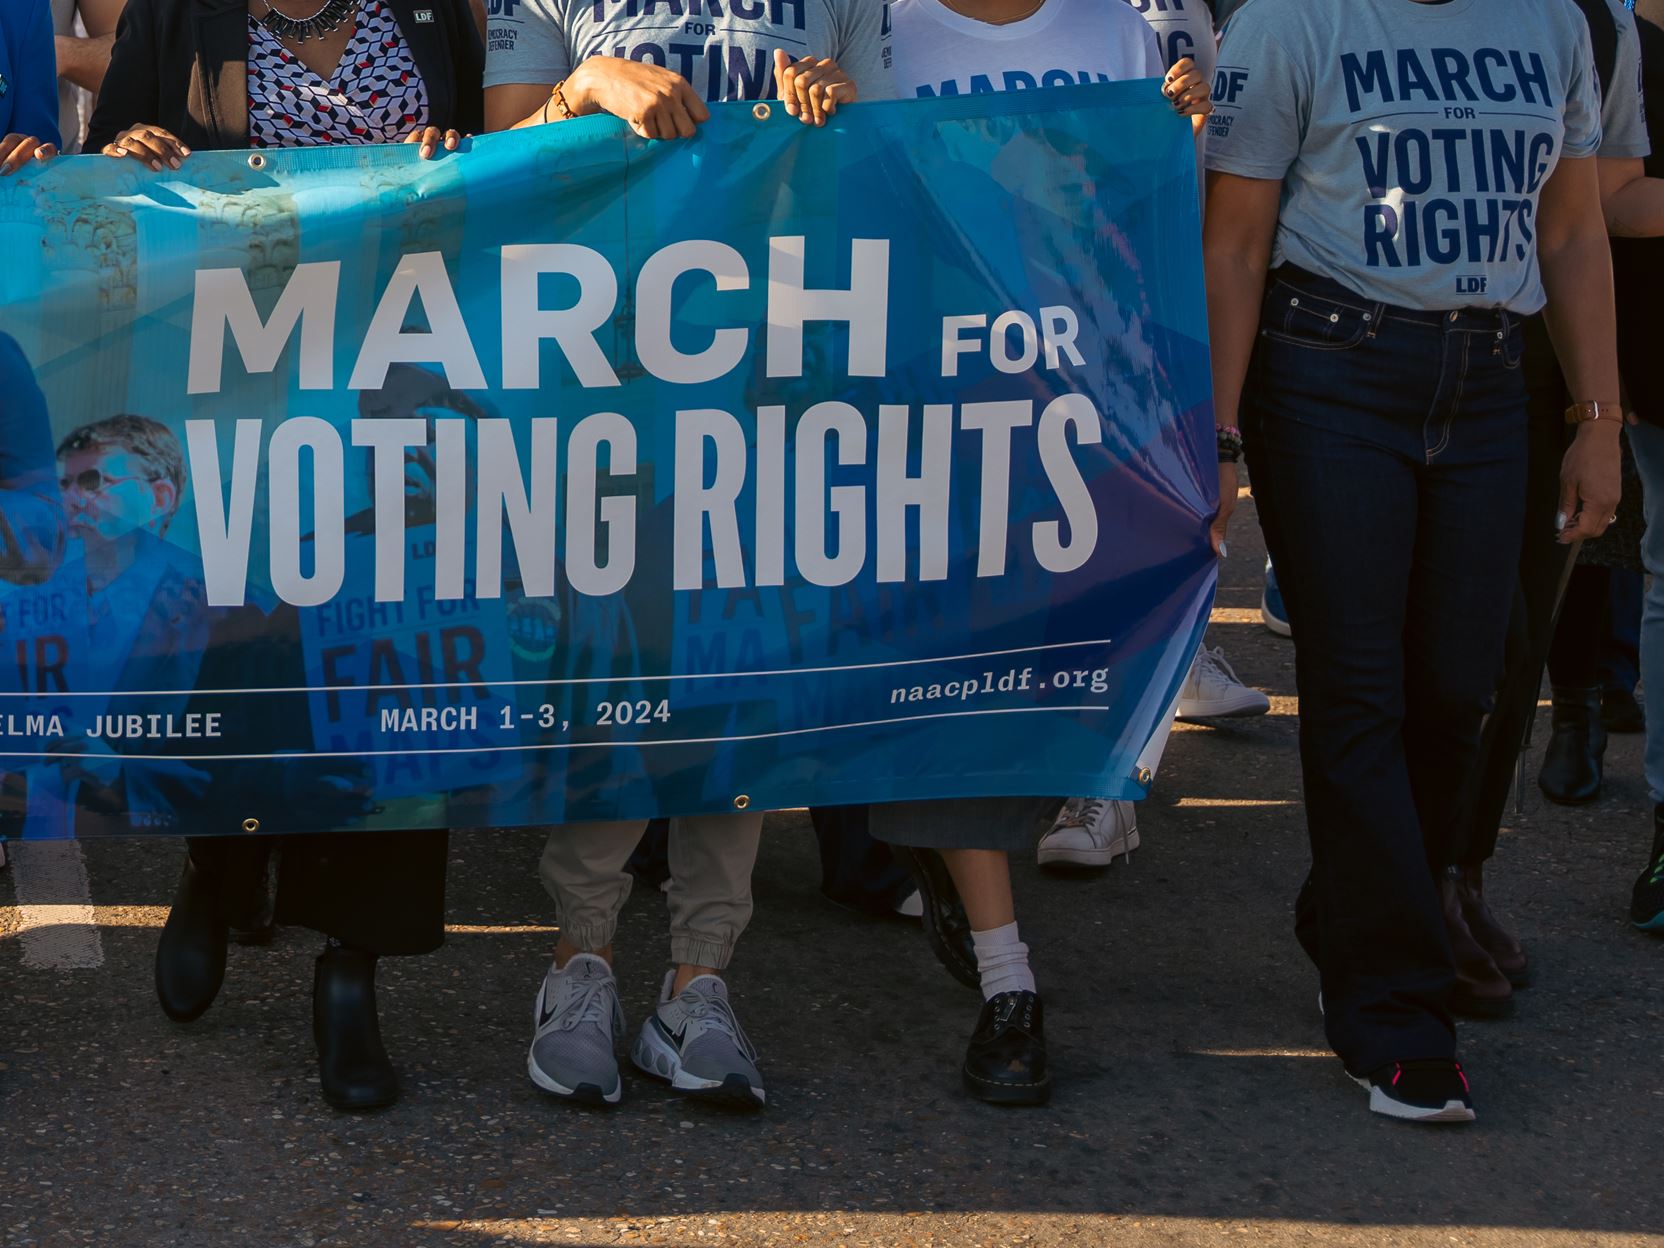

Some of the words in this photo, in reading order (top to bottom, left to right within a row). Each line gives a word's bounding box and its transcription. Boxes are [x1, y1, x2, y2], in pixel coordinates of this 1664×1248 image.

[416, 12, 432, 21] LDF
[684, 21, 716, 37] FOR
[1210, 70, 1249, 103] DF
[1340, 47, 1554, 113] MARCH
[1444, 106, 1476, 120] FOR
[1356, 127, 1555, 199] VOTING
[1363, 197, 1534, 268] RIGHTS
[1455, 276, 1487, 294] LDF
[187, 236, 890, 395] MARCH
[941, 305, 1086, 377] FOR
[186, 412, 637, 607] VOTING
[673, 393, 1103, 592] RIGHTS
[890, 664, 1110, 705] naacpldf.org
[86, 711, 224, 740] JUBILEE
[381, 705, 479, 734] MARCH
[498, 702, 571, 734] 1-3,
[596, 698, 672, 727] 2024
